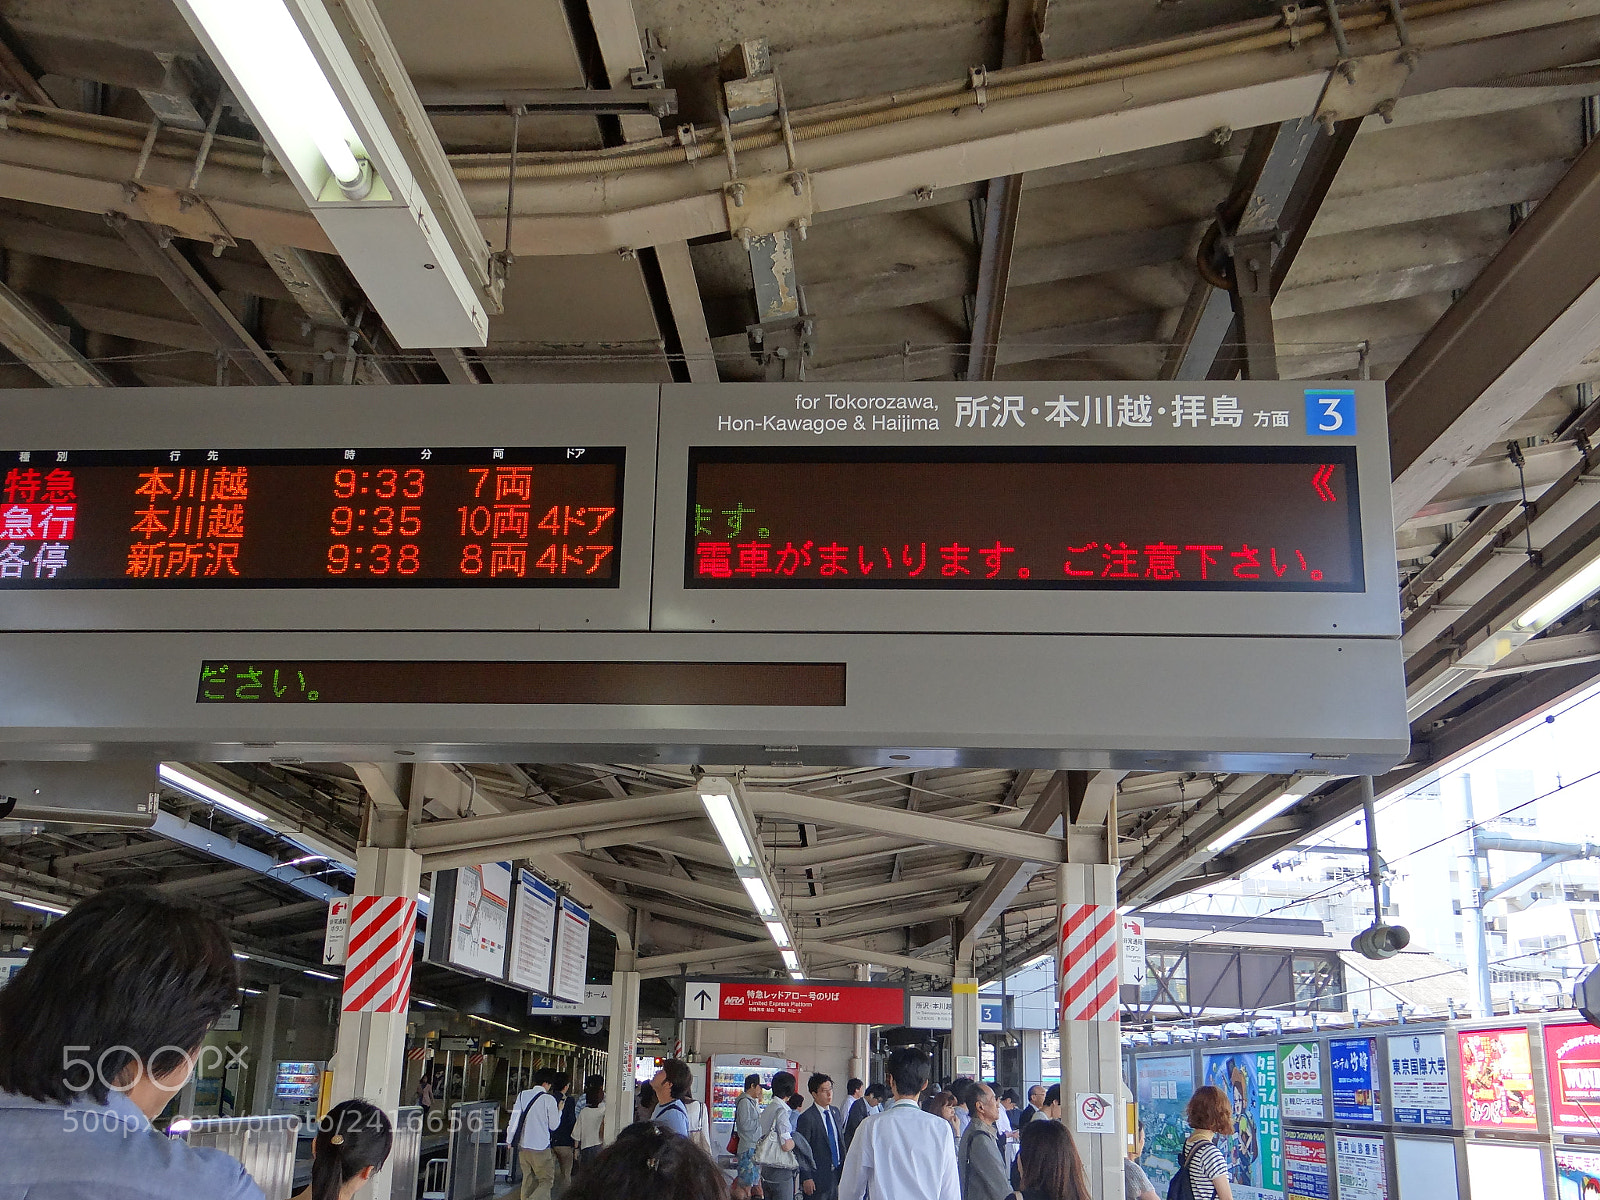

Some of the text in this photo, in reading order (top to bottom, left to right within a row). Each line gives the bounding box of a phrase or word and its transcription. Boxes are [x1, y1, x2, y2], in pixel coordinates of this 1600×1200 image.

[795, 394, 939, 414] for Tokorozawa,
[954, 394, 1290, 430] 所沢・本川越・拝島 方面
[717, 415, 940, 434] Hon-Kawagoe & Haijima
[1318, 399, 1344, 431] 3
[565, 447, 586, 459] ドア
[4, 468, 77, 502] 特急
[135, 467, 249, 502] 本川越
[333, 469, 425, 500] 9:33
[0, 504, 615, 540] 急行 本川越 9:35 10両 4ドア
[0, 542, 70, 578] 各停
[126, 541, 242, 579] 新所沢
[326, 543, 421, 575] 9:38
[535, 543, 615, 575] 4ドア
[746, 989, 840, 1002] 特急レッドアロー号のりば
[983, 1008, 992, 1020] 3
[1391, 1056, 1447, 1076] 東京国際大学
